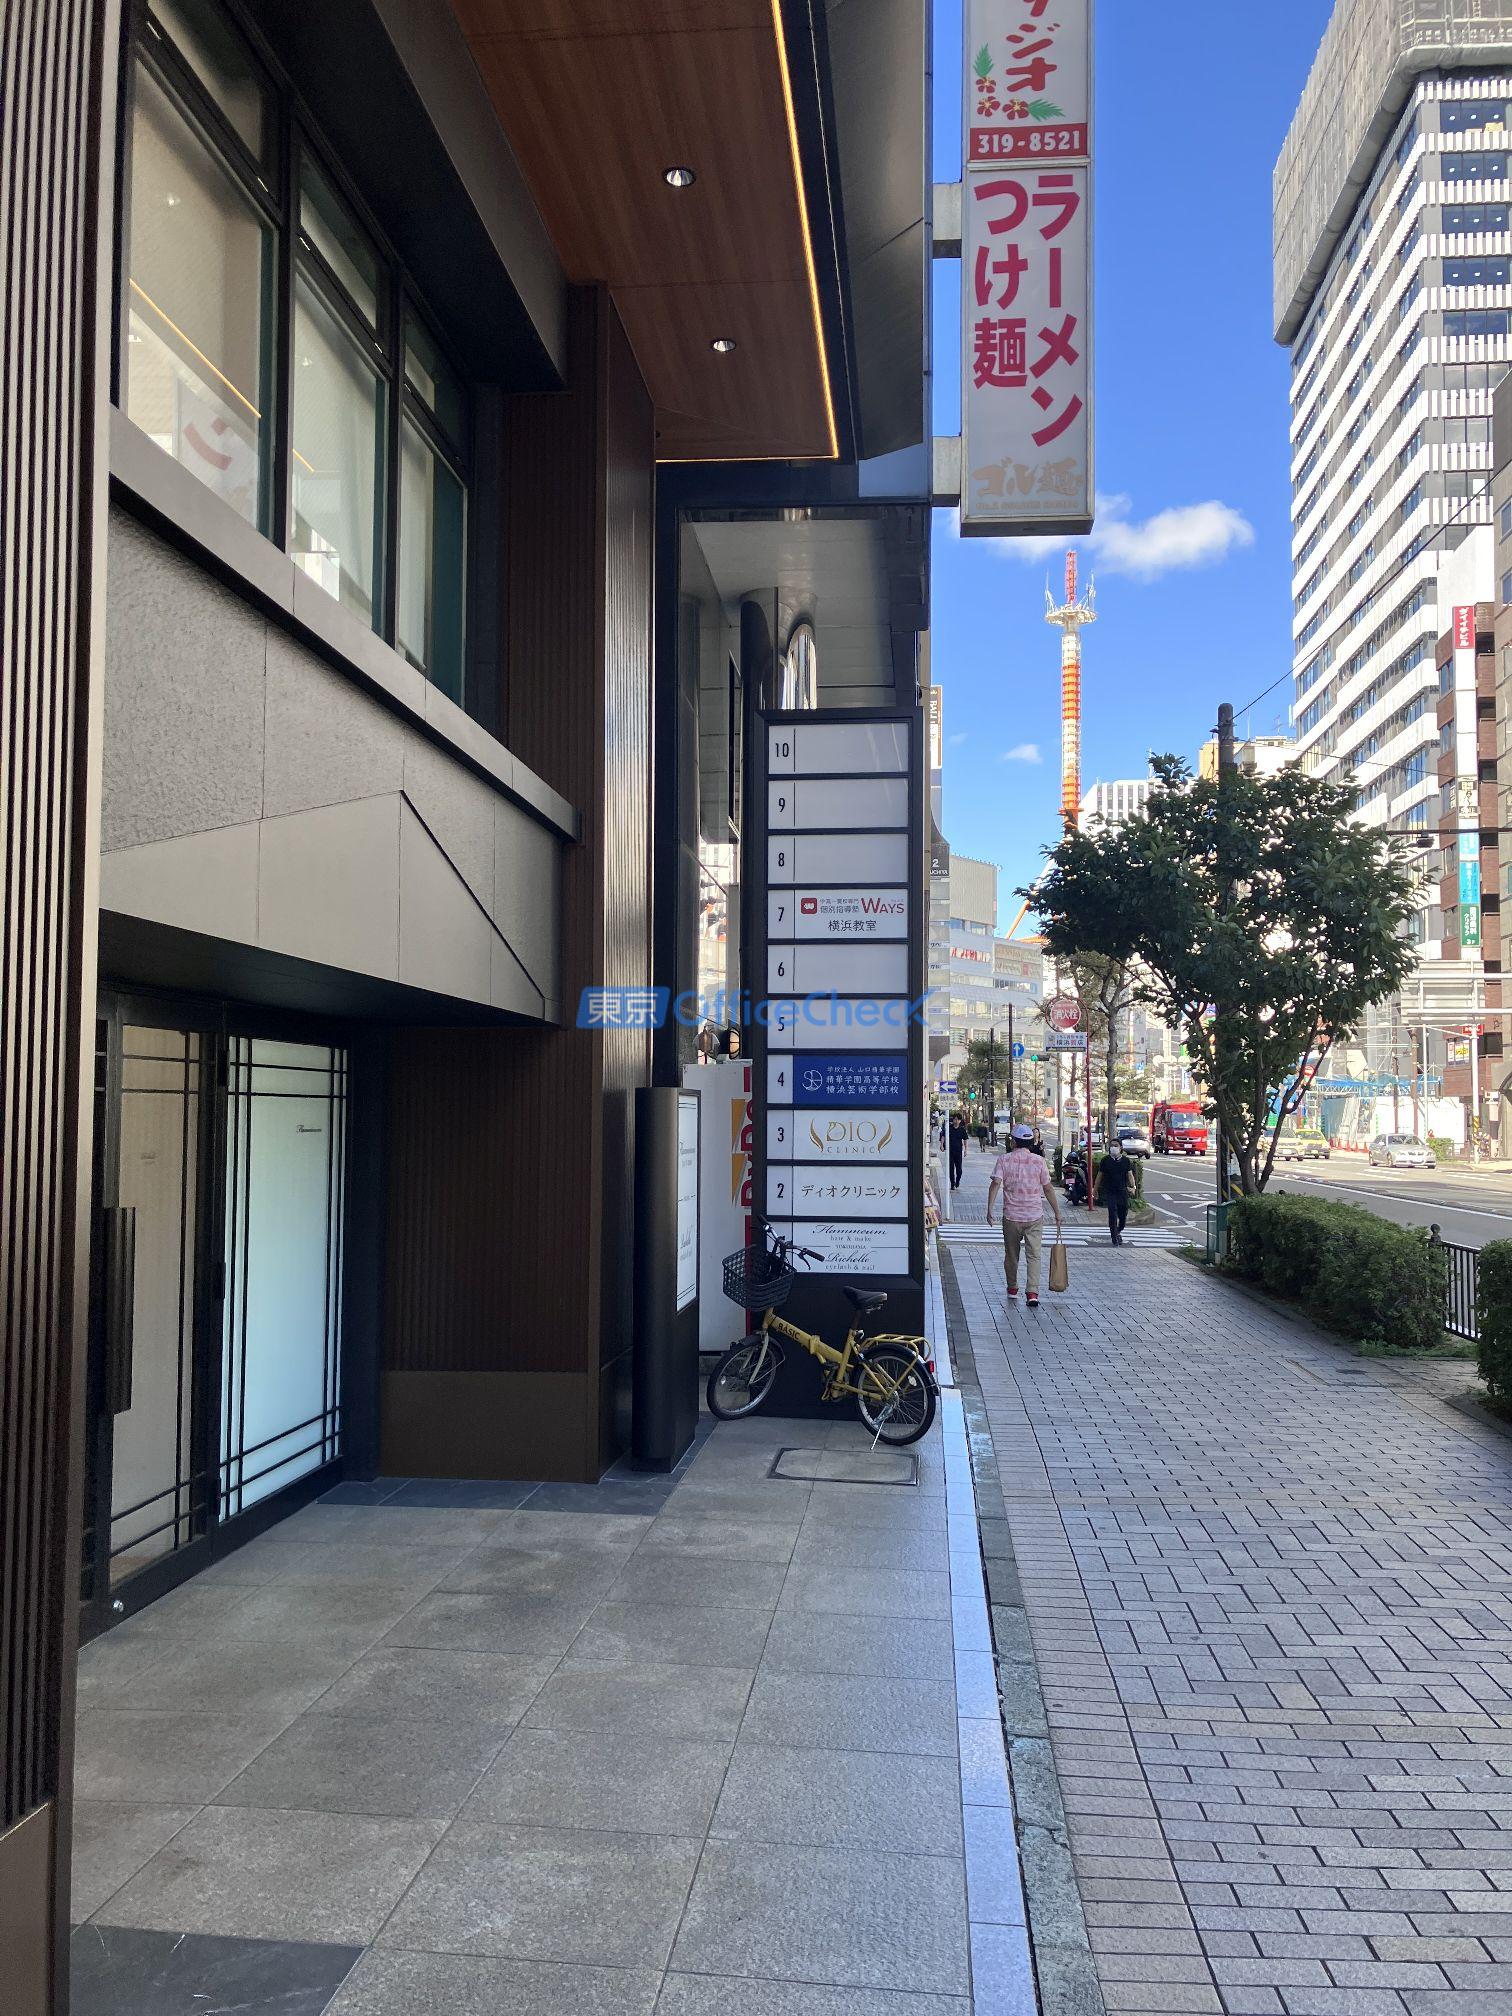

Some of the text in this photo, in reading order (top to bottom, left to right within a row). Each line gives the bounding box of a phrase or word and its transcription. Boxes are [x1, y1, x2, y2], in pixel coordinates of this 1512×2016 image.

[977, 130, 1080, 154] 319-8521
[974, 180, 1028, 390] つけ麺
[1030, 174, 1083, 448] ラーメン
[775, 743, 789, 758] 10
[778, 797, 786, 813] 9
[778, 852, 785, 867] 8
[778, 907, 785, 922] 7
[828, 919, 877, 932] 横浜教室
[777, 961, 785, 977] 6
[1054, 1009, 1078, 1020] 消火栓
[778, 1016, 785, 1032] 5
[777, 1072, 785, 1087] 4
[777, 1127, 784, 1142] 3
[827, 1146, 875, 1154] CLINIC
[777, 1183, 784, 1199] 2
[801, 1184, 901, 1199] ディオクリニック
